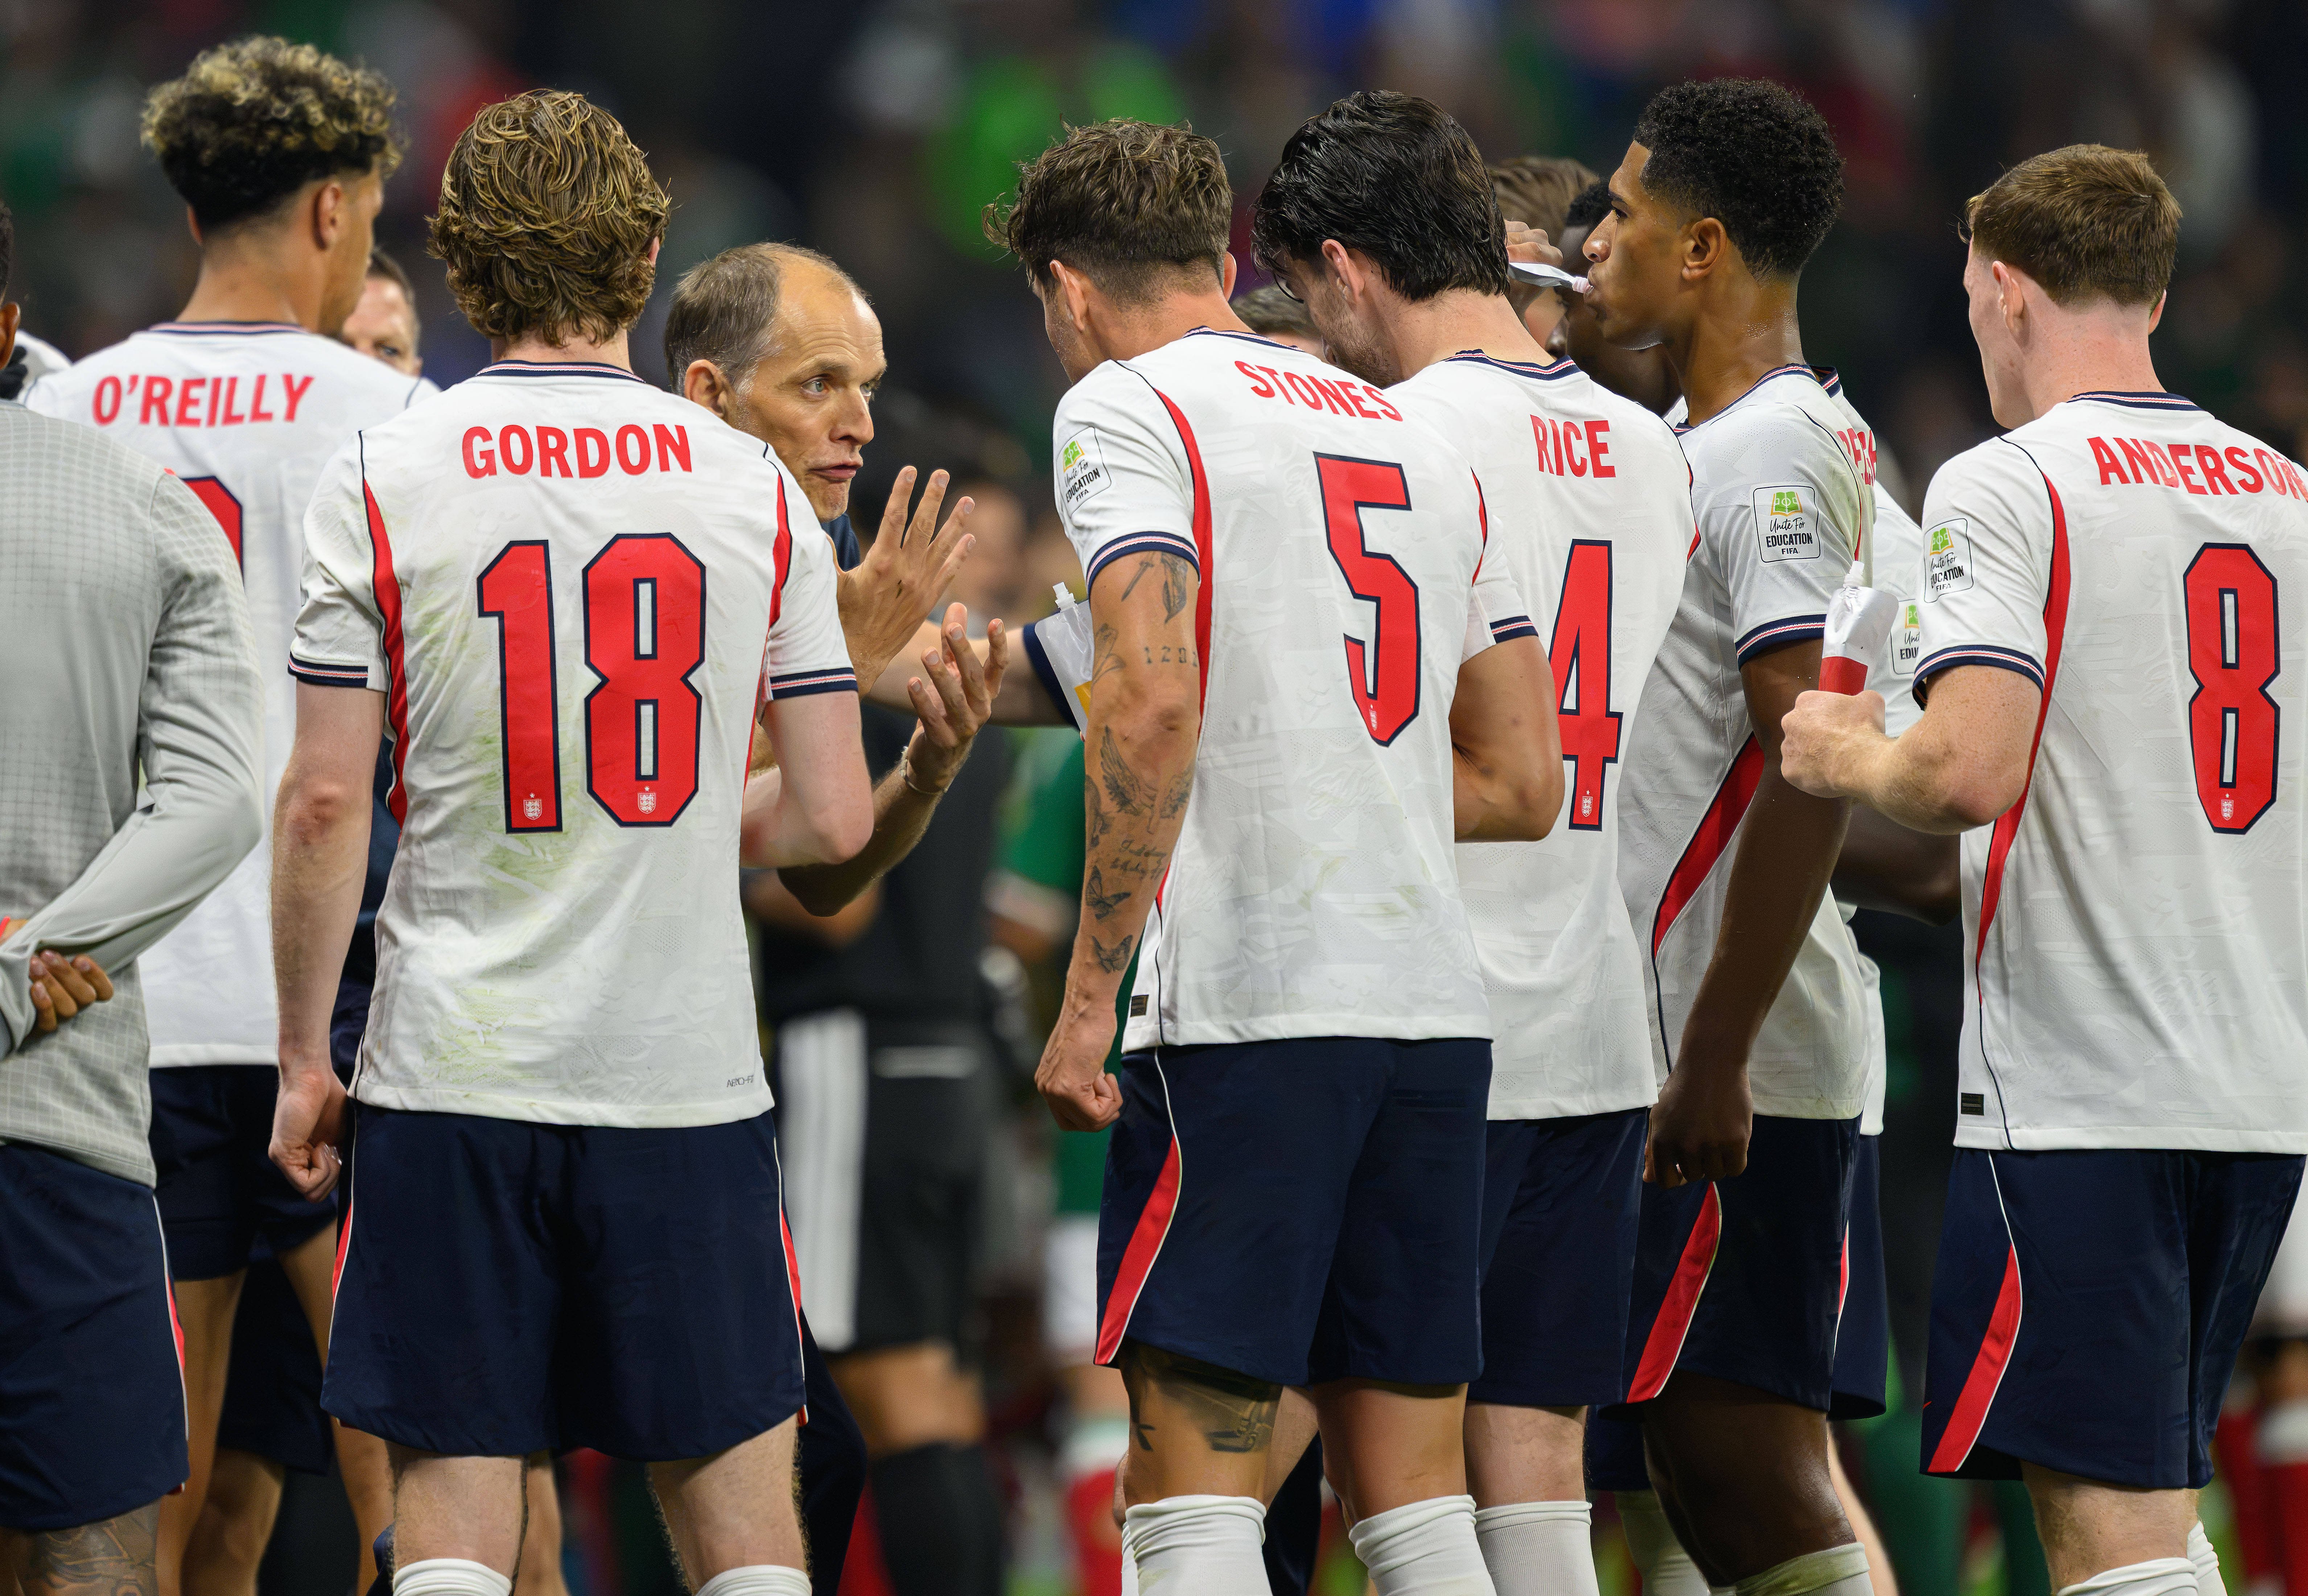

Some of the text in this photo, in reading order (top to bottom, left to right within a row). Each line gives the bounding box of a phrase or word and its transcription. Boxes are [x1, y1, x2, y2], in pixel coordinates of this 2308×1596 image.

[1235, 361, 1403, 422] STONES
[462, 424, 692, 479] GORDON
[1530, 414, 1616, 479] RICE
[2087, 436, 2308, 503] ANDERSON
[1066, 468, 1100, 503] EDUCATION
[1076, 489, 1089, 502] FIFA
[1766, 533, 1813, 548] EDUCATION
[1770, 517, 1805, 533] Unite For
[1945, 552, 1957, 566] For
[1313, 451, 1421, 748] 5
[1936, 583, 1951, 592] FIFA
[1905, 631, 1920, 646] Unit
[477, 533, 706, 834] 18
[1550, 539, 1624, 831] 4
[2183, 542, 2280, 835] 8
